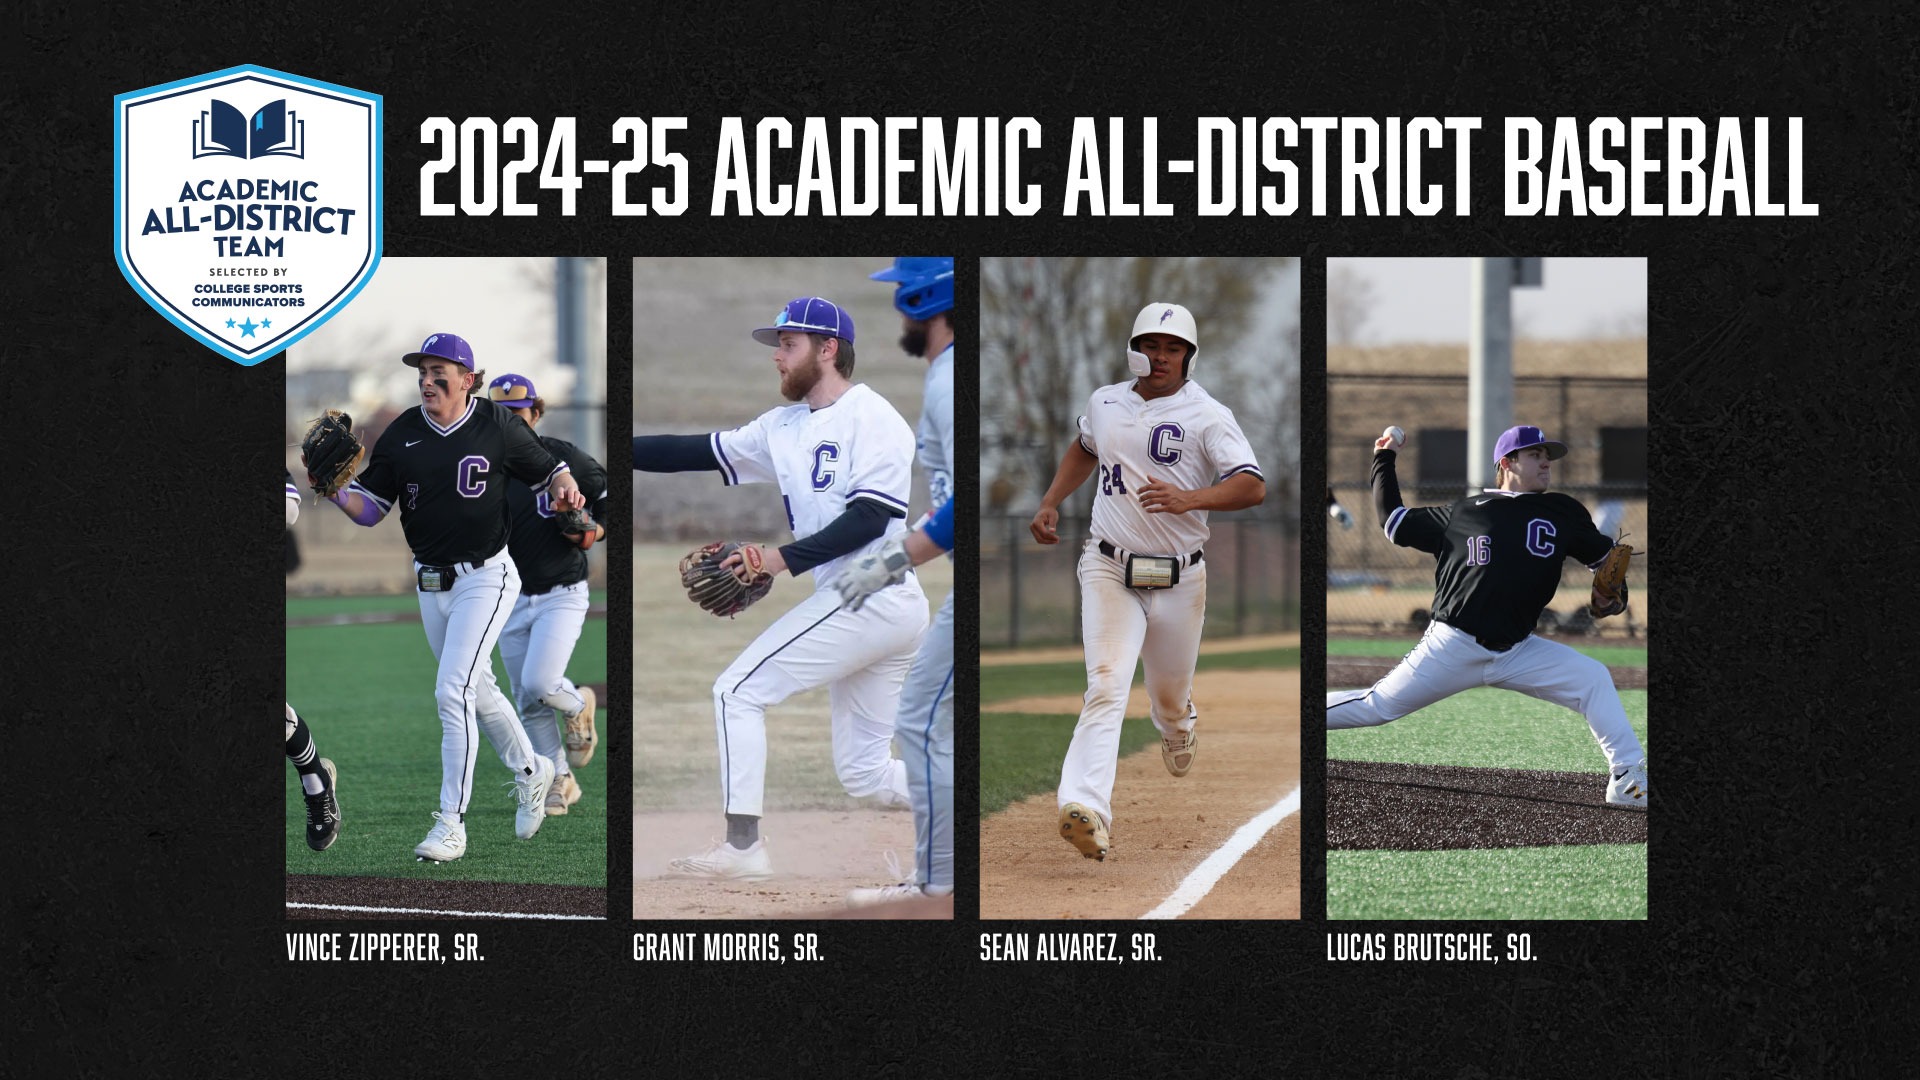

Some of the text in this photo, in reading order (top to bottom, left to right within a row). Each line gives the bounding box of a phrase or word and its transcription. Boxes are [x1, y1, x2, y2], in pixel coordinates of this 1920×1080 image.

[1148, 422, 1185, 467] C
[457, 456, 490, 498] C
[811, 440, 841, 492] C
[1101, 464, 1127, 496] 24
[407, 484, 418, 510] 7
[1466, 535, 1492, 566] 16
[1526, 518, 1557, 558] C
